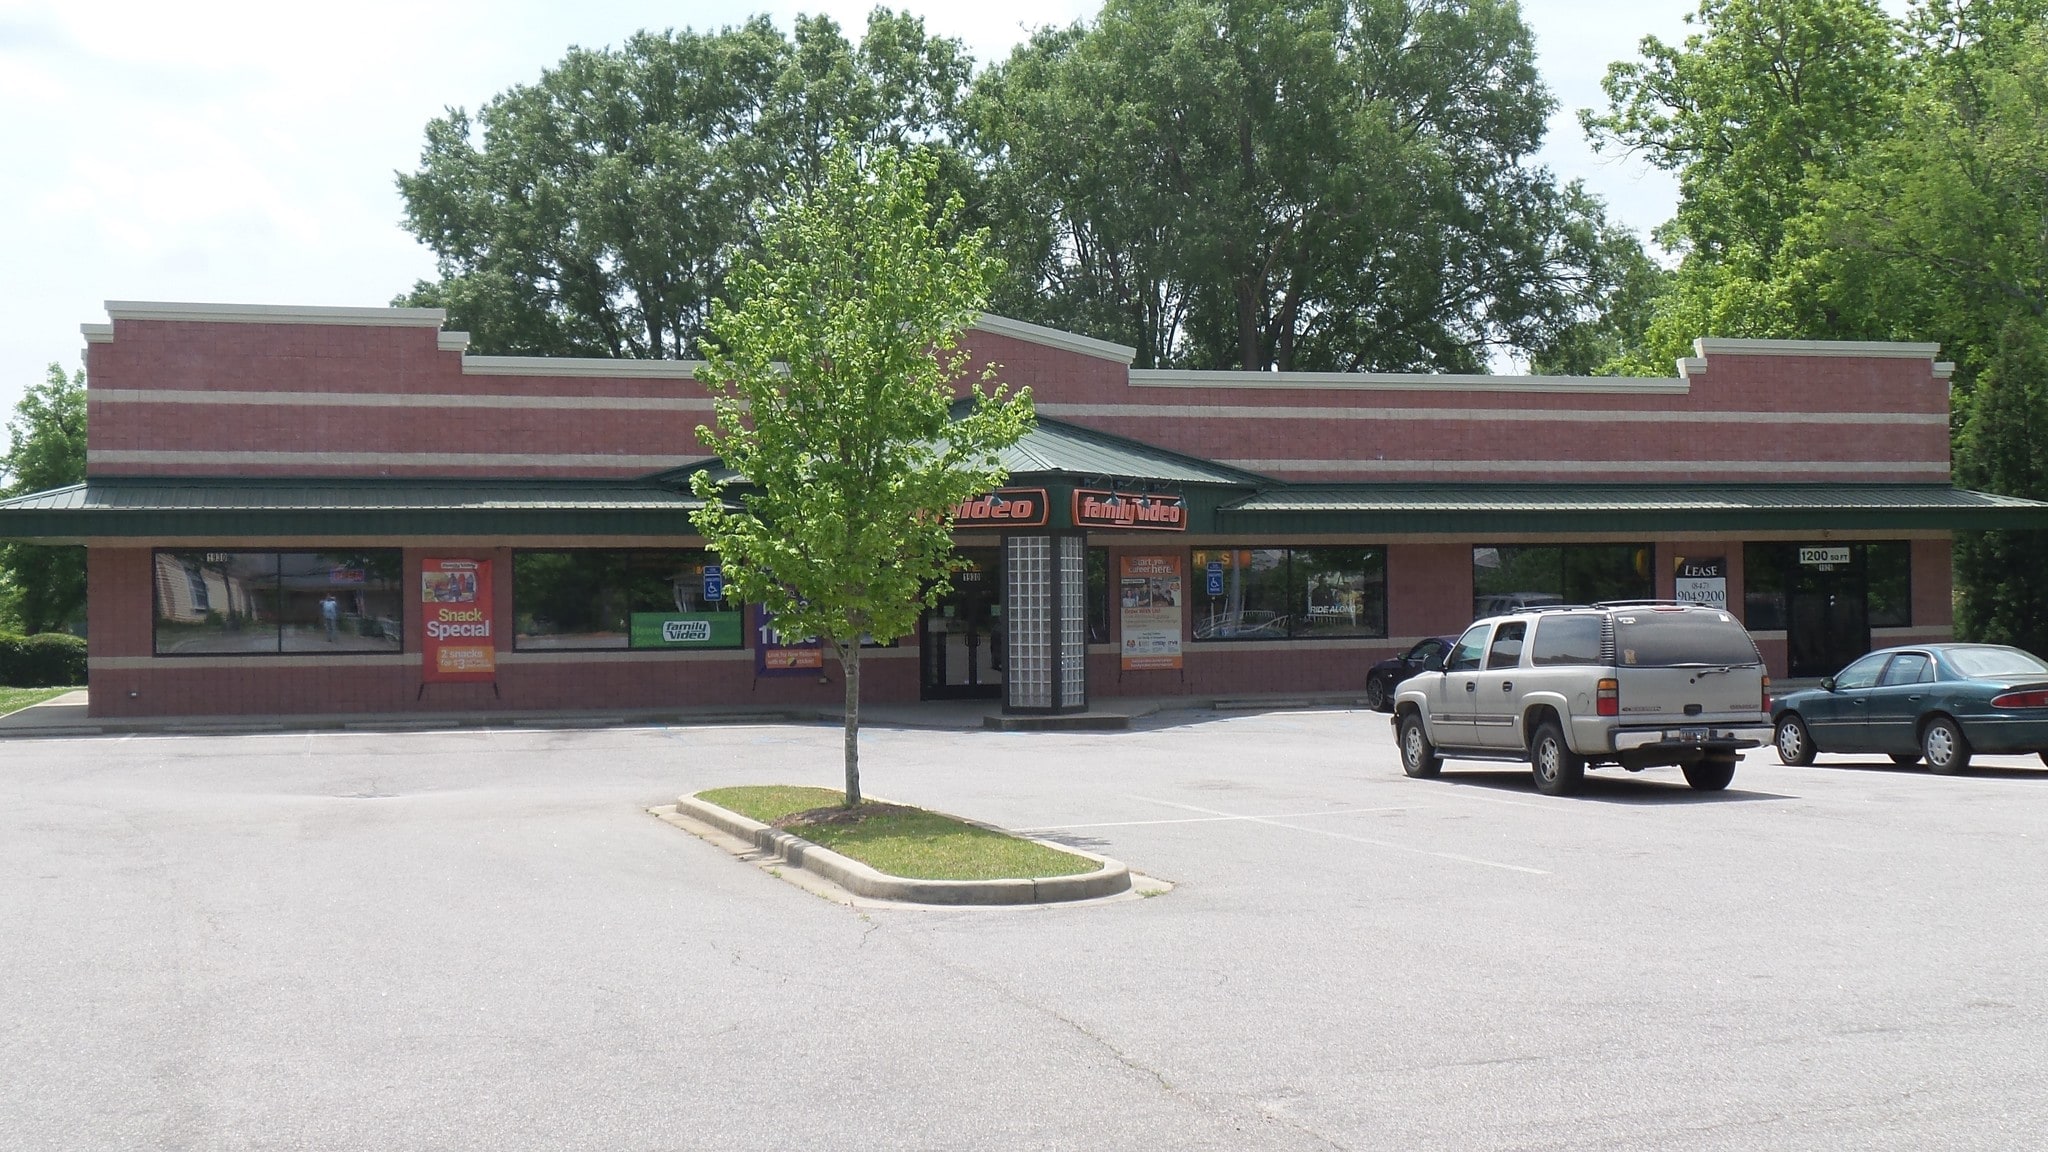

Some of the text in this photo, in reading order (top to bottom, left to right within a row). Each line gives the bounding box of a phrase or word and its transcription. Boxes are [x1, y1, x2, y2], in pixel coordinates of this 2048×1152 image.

[1084, 496, 1180, 525] family Video
[1801, 550, 1828, 561] 1200
[962, 572, 981, 581] 1930
[1685, 565, 1718, 577] LEASE
[1310, 604, 1364, 614] RIDE ALONG 2
[439, 608, 482, 622] Snack
[427, 620, 490, 641] Special
[666, 622, 707, 634] family
[666, 630, 706, 640] Video
[441, 648, 483, 659] 2 snacks
